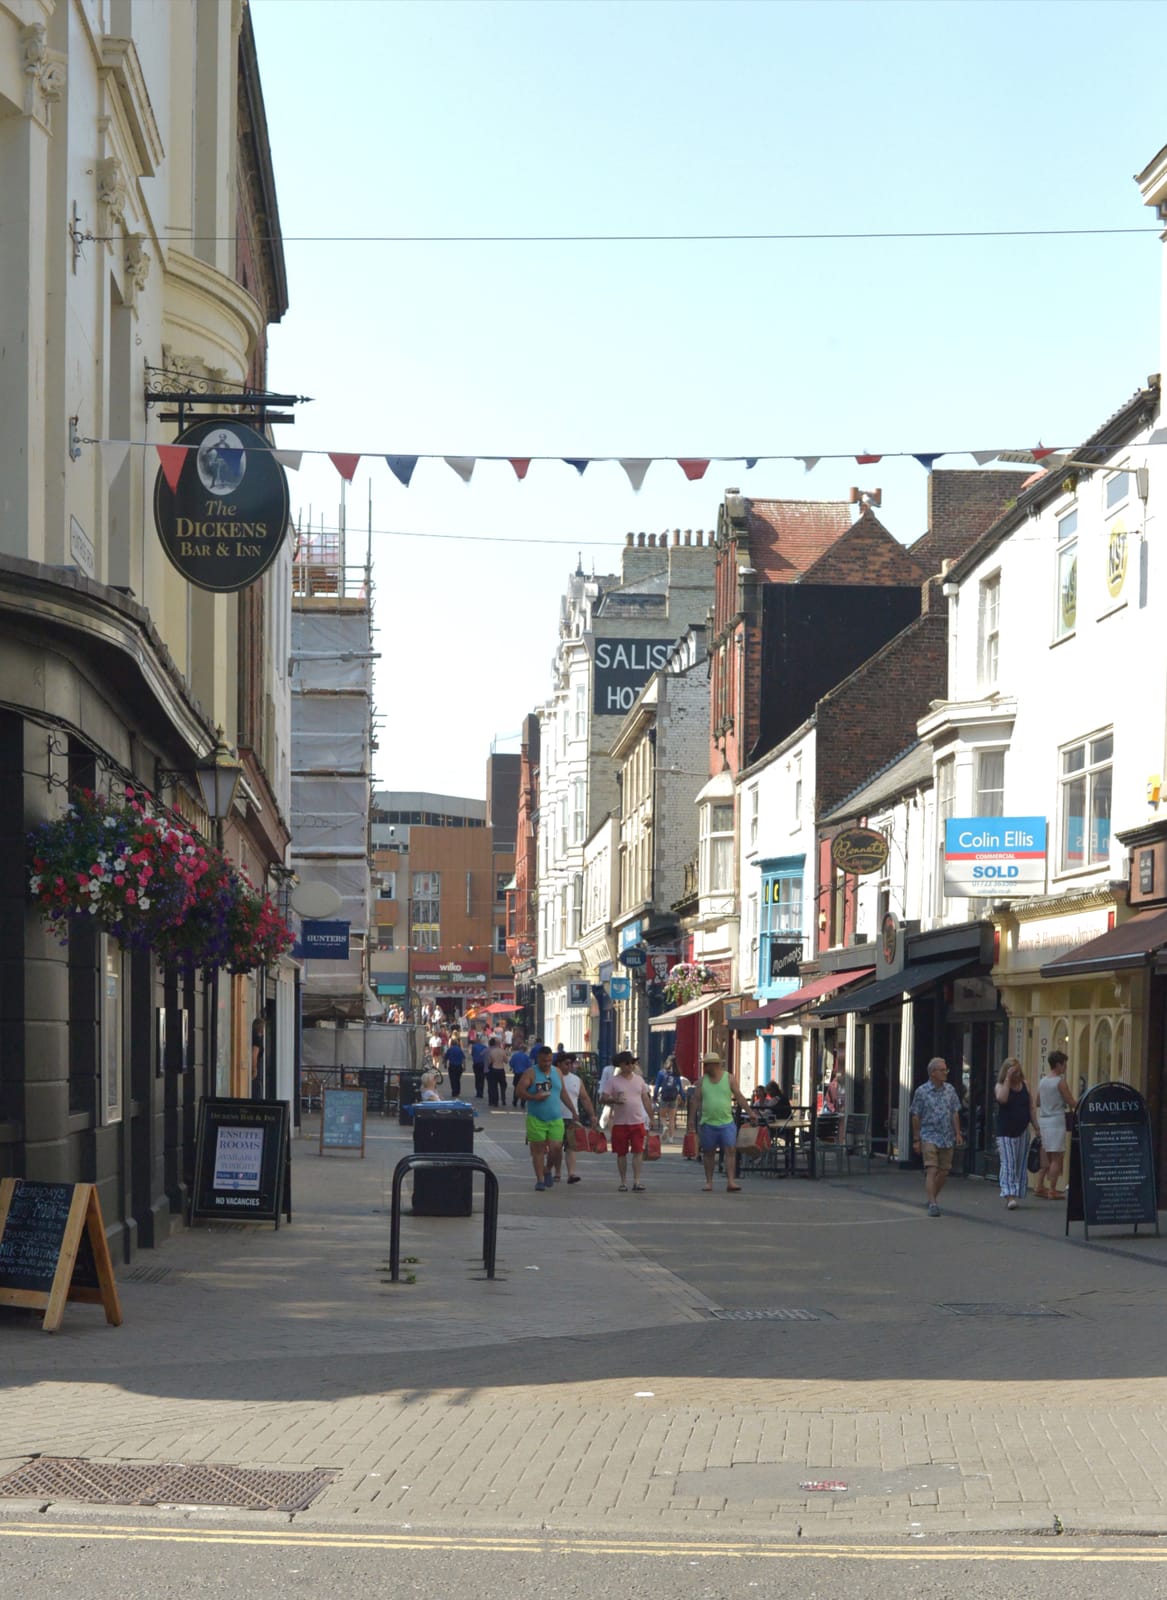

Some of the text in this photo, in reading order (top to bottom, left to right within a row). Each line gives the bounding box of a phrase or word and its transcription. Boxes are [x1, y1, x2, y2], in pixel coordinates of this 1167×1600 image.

[206, 500, 237, 516] The
[175, 517, 267, 538] DICKENS
[216, 542, 230, 556] &
[959, 830, 1034, 848] Colin Ellis
[973, 865, 1019, 878] SOLD
[440, 962, 462, 971] wilko
[1088, 1101, 1139, 1112] BRADLEYS
[219, 1140, 260, 1150] ROOMS
[215, 1197, 260, 1206] NO VACANCIES
